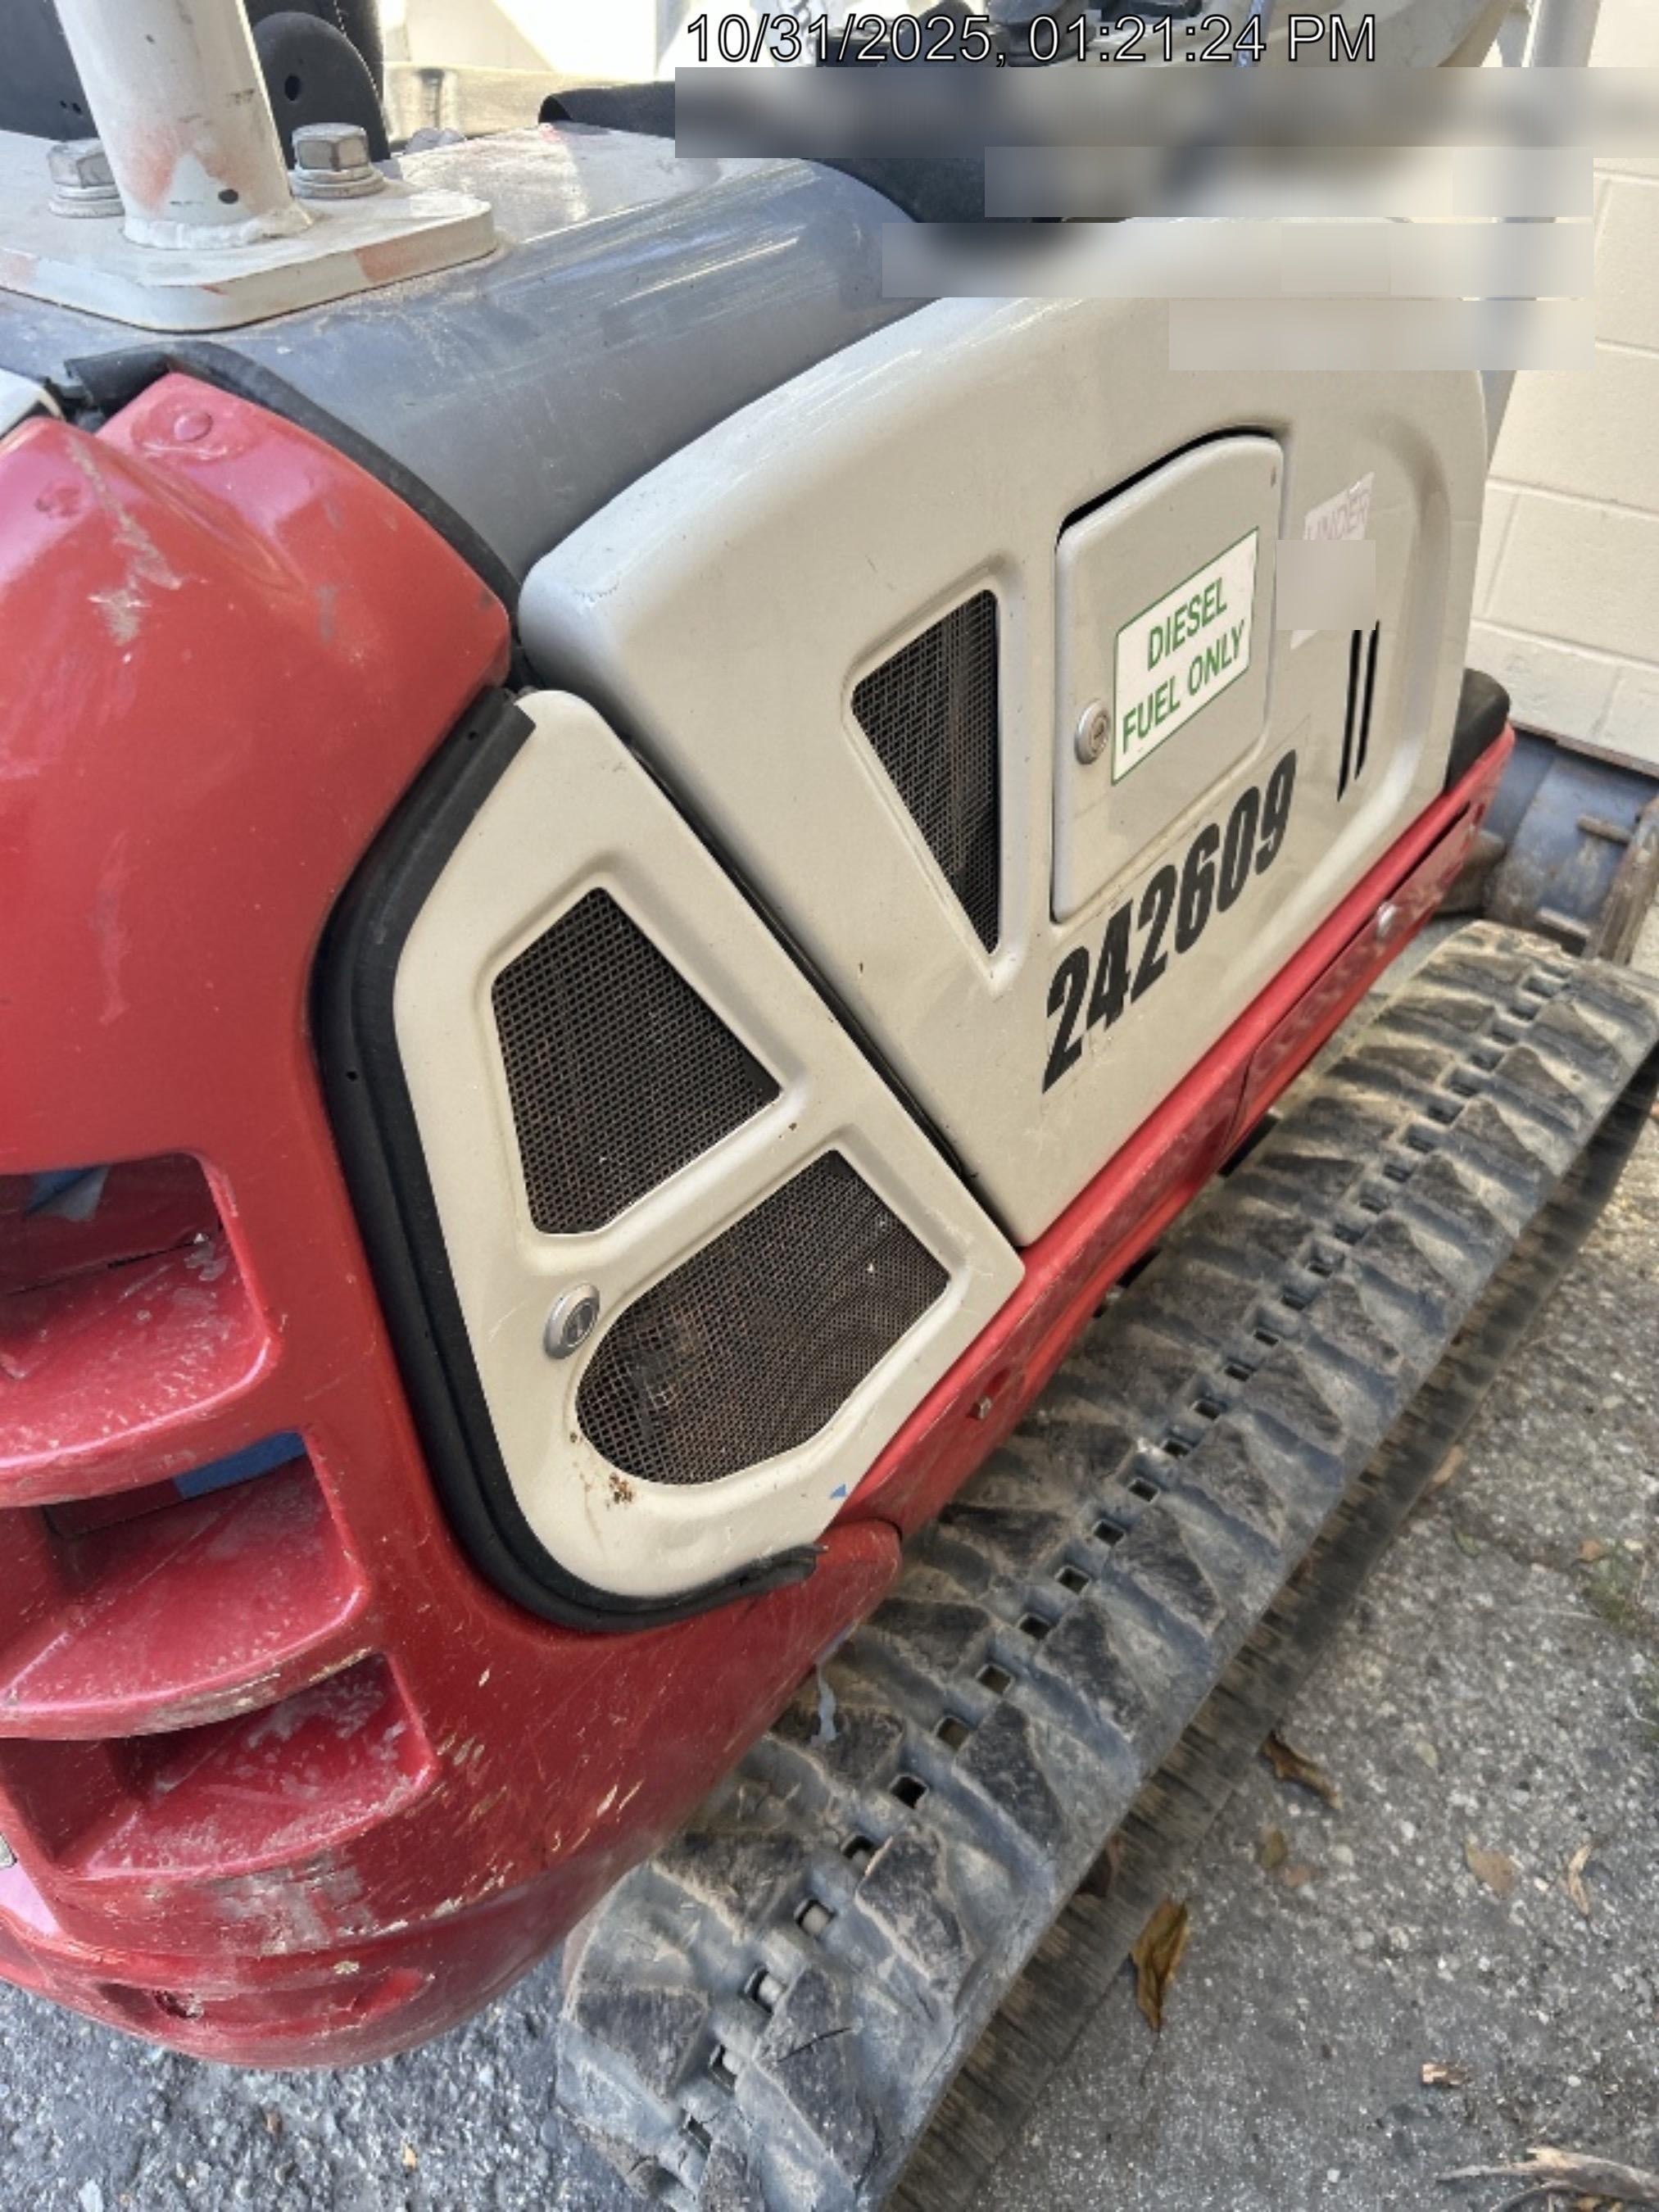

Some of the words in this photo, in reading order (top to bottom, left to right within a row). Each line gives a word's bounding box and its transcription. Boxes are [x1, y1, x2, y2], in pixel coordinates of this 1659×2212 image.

[1122, 676, 1181, 754] FUEL
[1188, 619, 1244, 696] ONLY
[1149, 578, 1226, 669] DIESEL
[1043, 749, 1296, 1095] 242609
